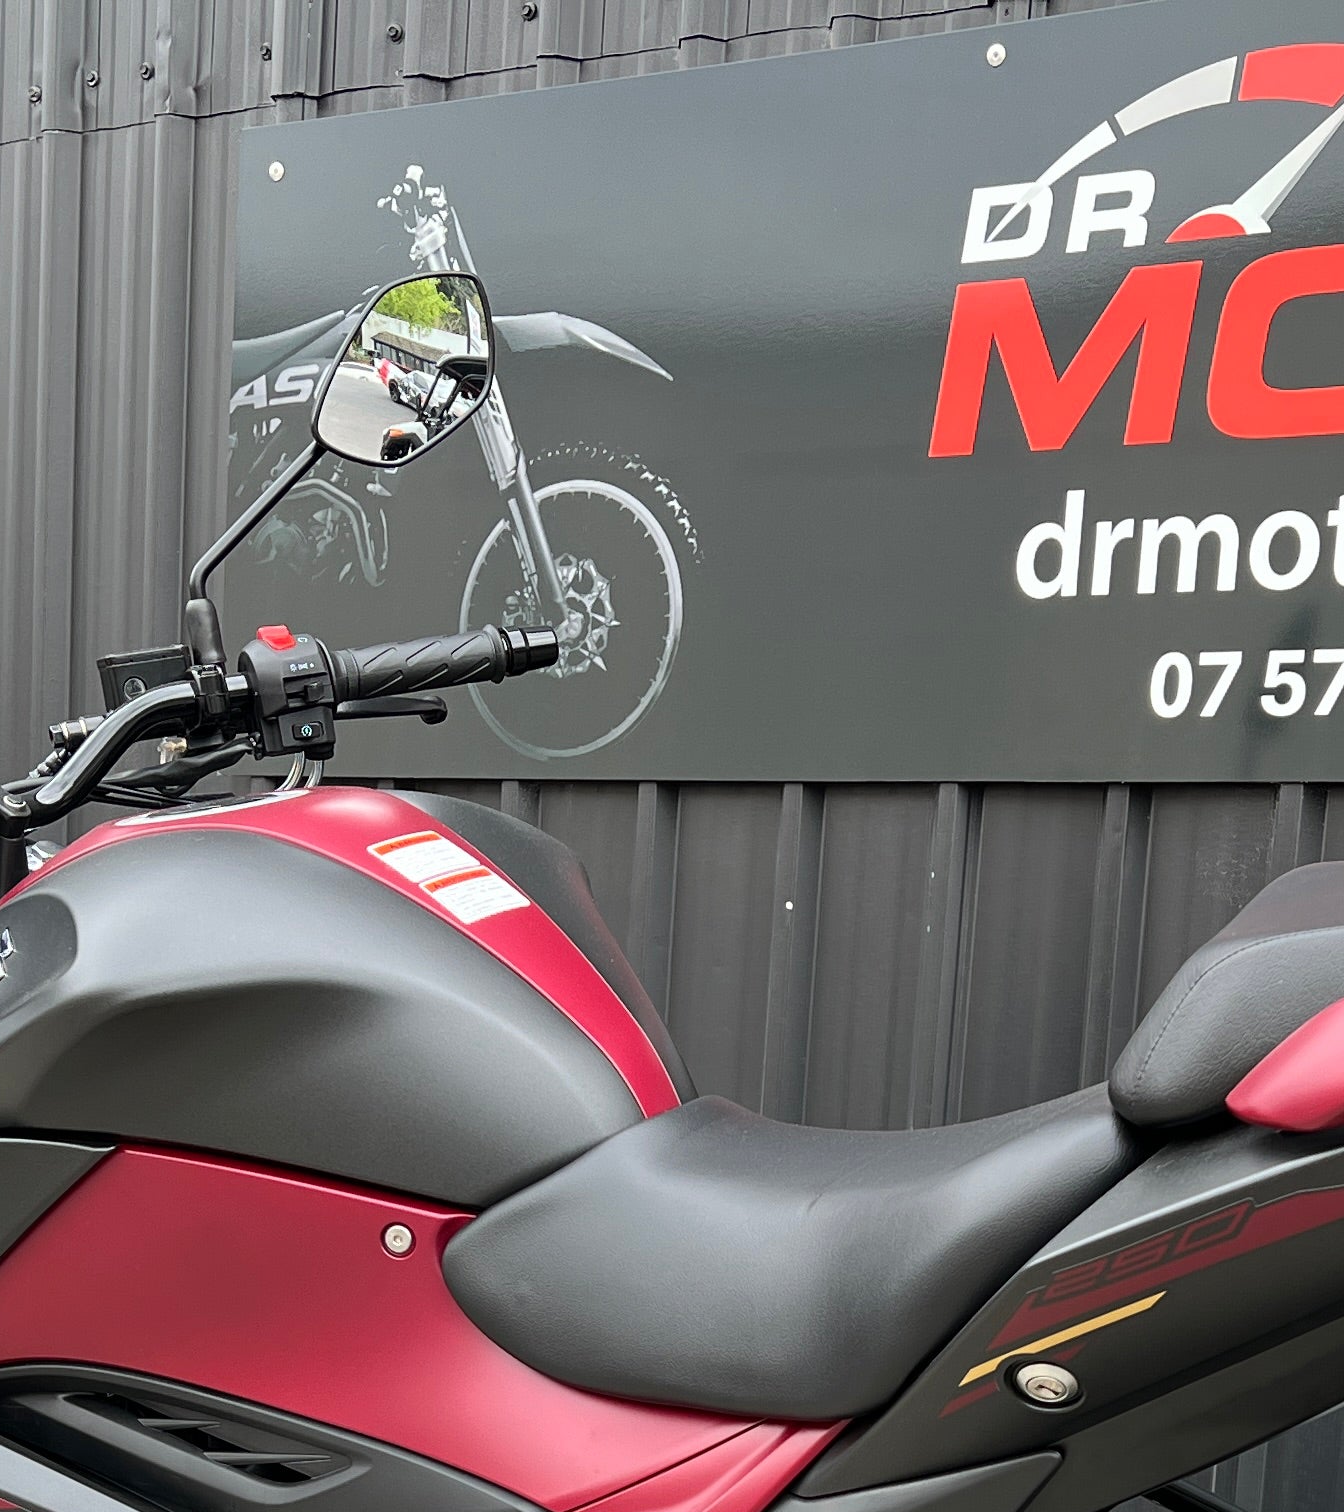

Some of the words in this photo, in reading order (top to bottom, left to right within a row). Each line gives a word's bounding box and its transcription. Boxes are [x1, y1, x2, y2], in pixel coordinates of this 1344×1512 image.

[961, 169, 1157, 266] DR
[229, 363, 332, 414] AS
[1149, 650, 1243, 719] 07
[1044, 1201, 1250, 1301] 250
